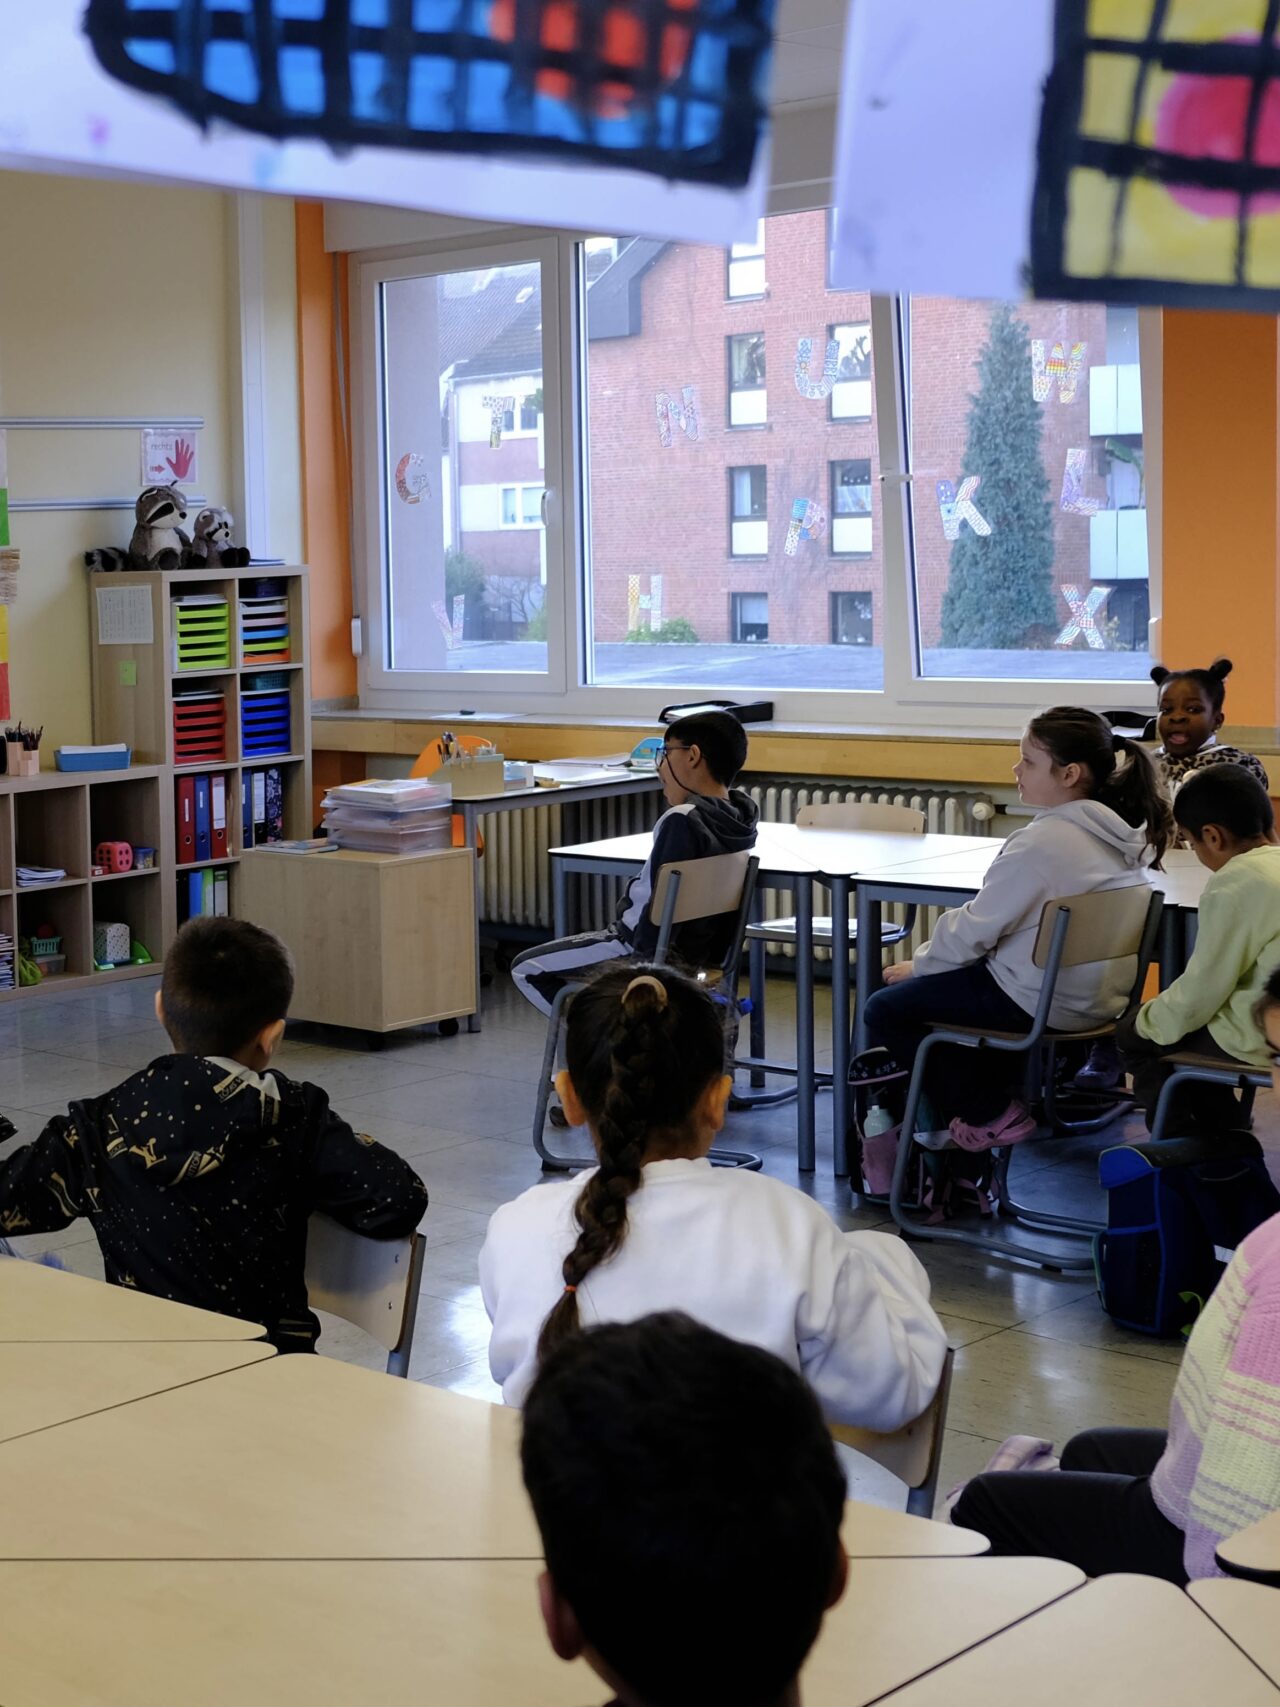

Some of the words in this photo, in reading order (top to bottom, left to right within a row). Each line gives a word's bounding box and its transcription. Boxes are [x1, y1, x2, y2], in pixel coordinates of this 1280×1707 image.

[794, 337, 840, 400] U
[1031, 339, 1088, 404] W
[482, 395, 516, 449] T
[655, 385, 699, 448] N
[395, 453, 432, 504] G
[935, 475, 992, 541] K
[1060, 448, 1099, 518] L
[431, 594, 465, 650] V
[628, 575, 663, 631] H
[1054, 584, 1113, 649] X
